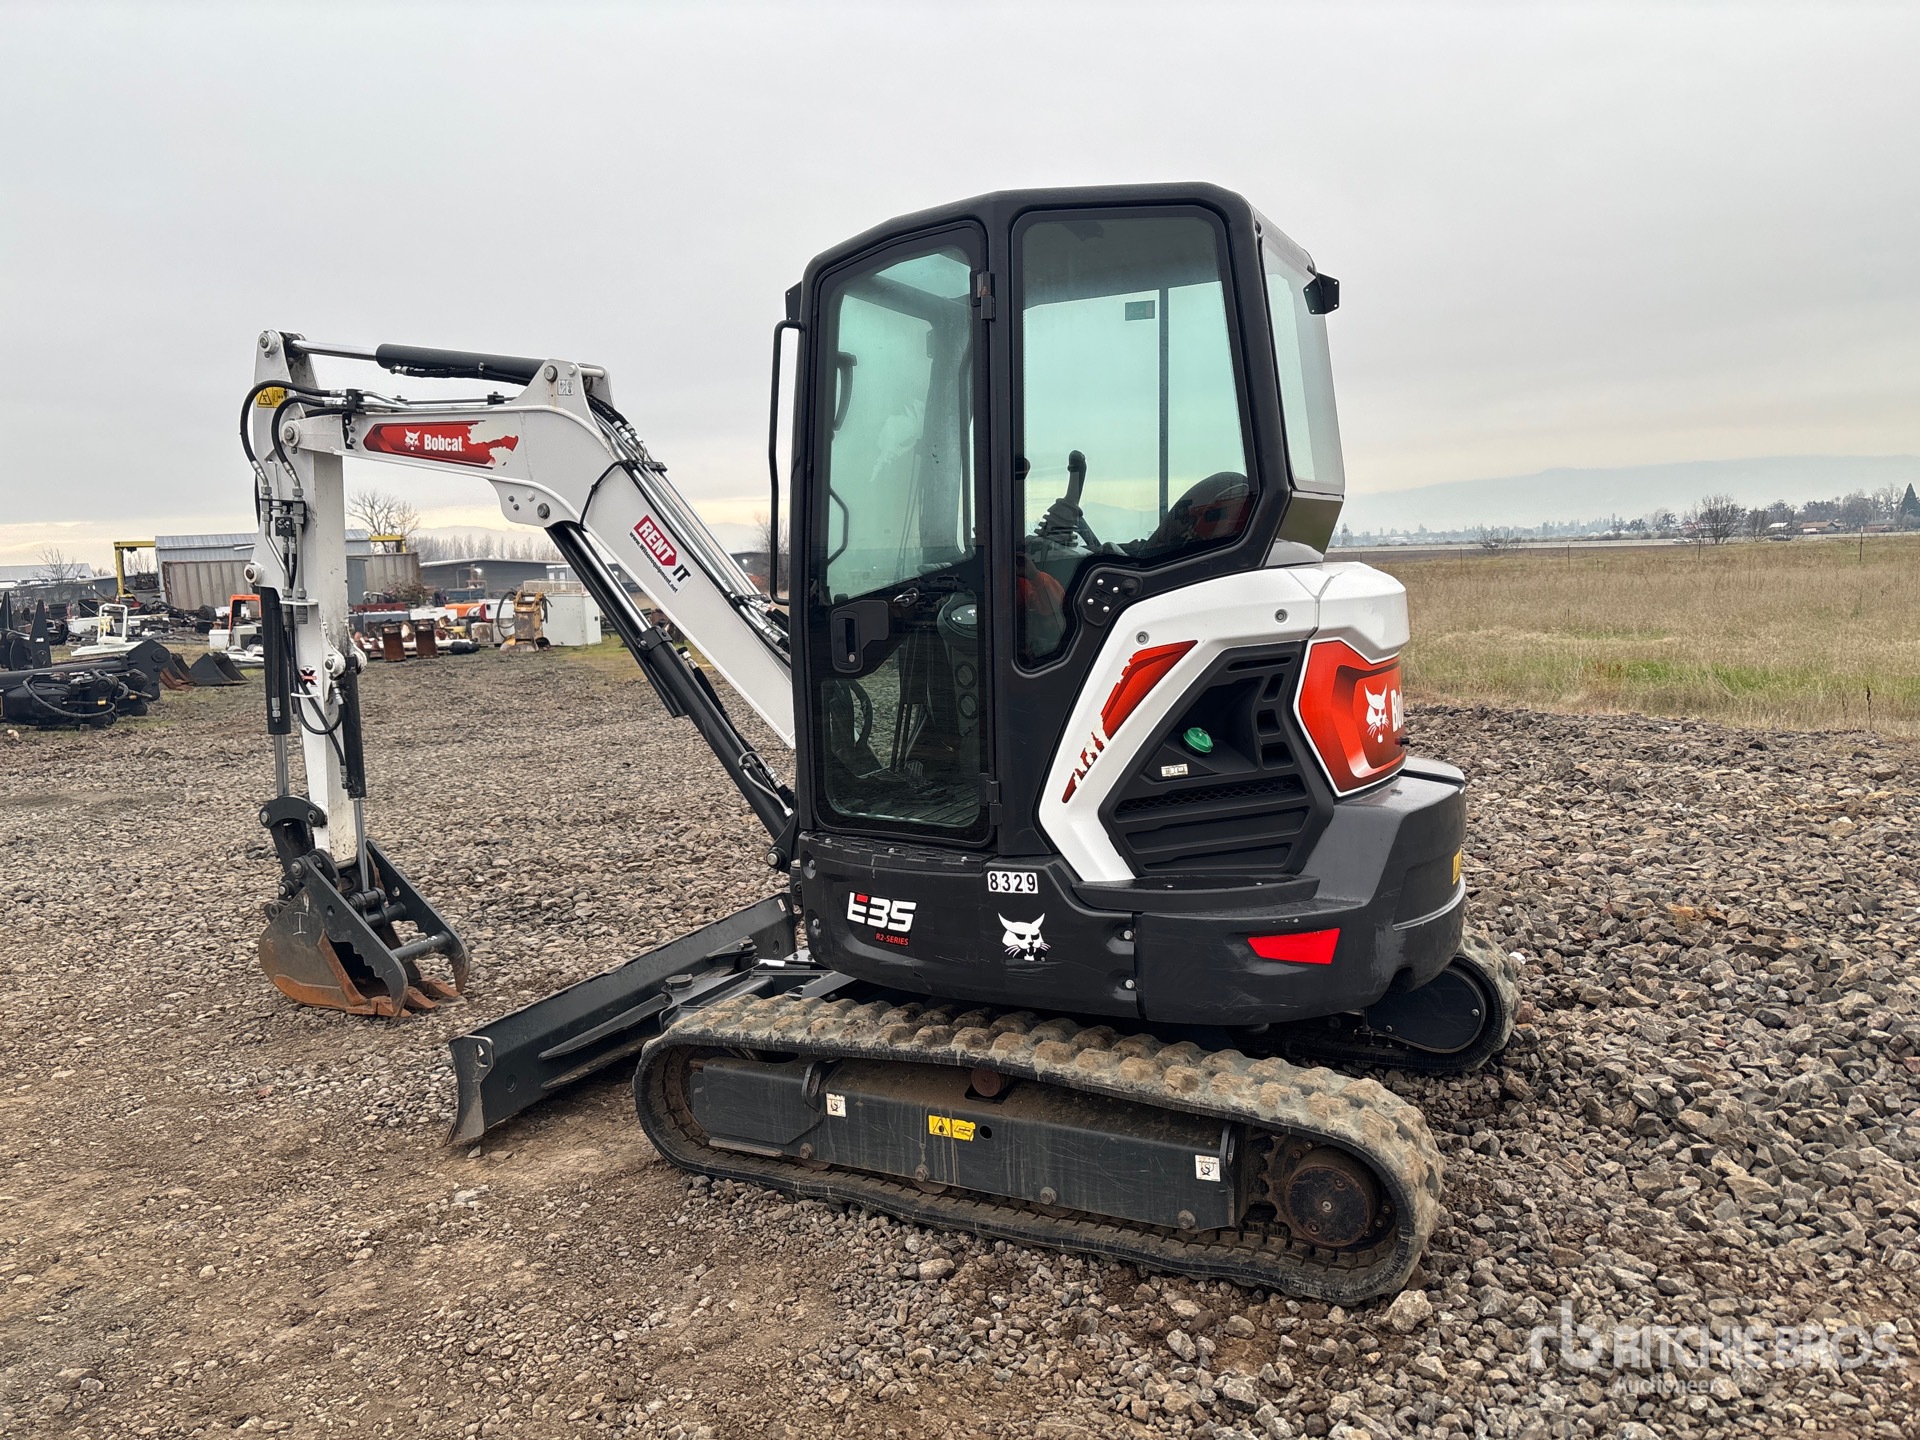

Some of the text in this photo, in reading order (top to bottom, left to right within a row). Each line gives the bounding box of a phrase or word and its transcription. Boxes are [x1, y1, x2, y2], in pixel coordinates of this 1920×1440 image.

[424, 434, 464, 452] Bobcat
[638, 520, 691, 582] RENT IT
[989, 872, 1036, 892] 8329
[847, 891, 917, 933] E35
[875, 932, 909, 946] R2-SERIES
